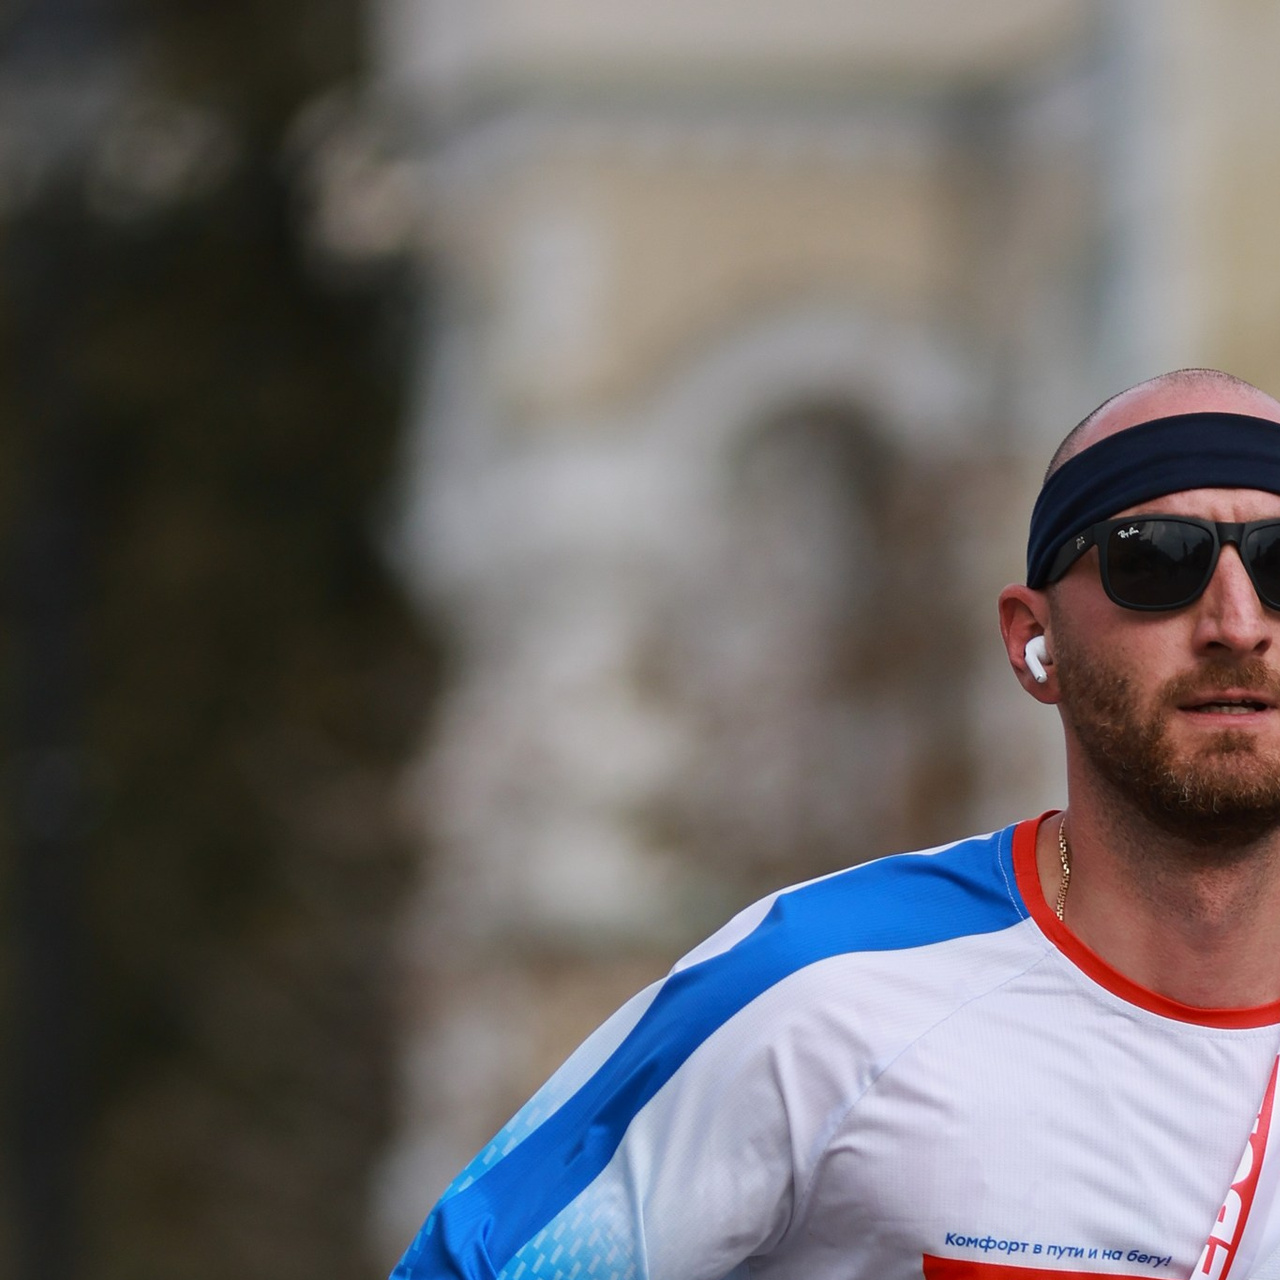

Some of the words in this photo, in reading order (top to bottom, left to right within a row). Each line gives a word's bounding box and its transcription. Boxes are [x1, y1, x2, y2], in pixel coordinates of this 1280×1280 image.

[944, 1232, 1029, 1256] Комфорт
[1033, 1243, 1042, 1254] в
[1048, 1244, 1084, 1259] пути
[1088, 1248, 1097, 1259] и
[1102, 1248, 1122, 1260] на
[1126, 1249, 1173, 1268] бегу!
